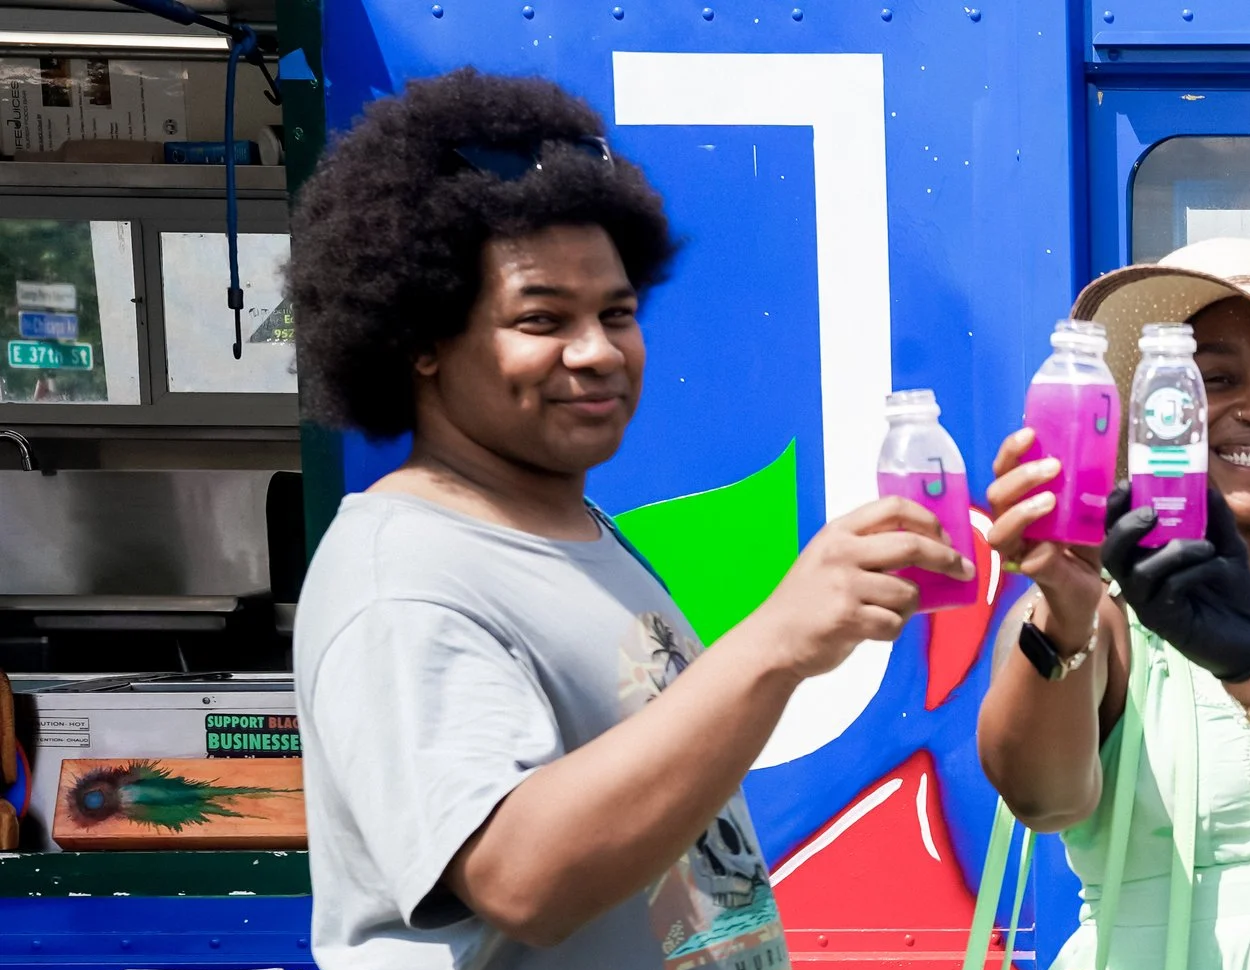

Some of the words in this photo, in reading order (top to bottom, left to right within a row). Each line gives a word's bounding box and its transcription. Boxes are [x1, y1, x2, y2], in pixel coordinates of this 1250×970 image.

[13, 345, 22, 363] E
[29, 346, 63, 364] 37th
[71, 348, 89, 366] St
[207, 715, 265, 729] SUPPORT
[268, 717, 299, 729] BLAC
[207, 732, 302, 751] BUSINESSE
